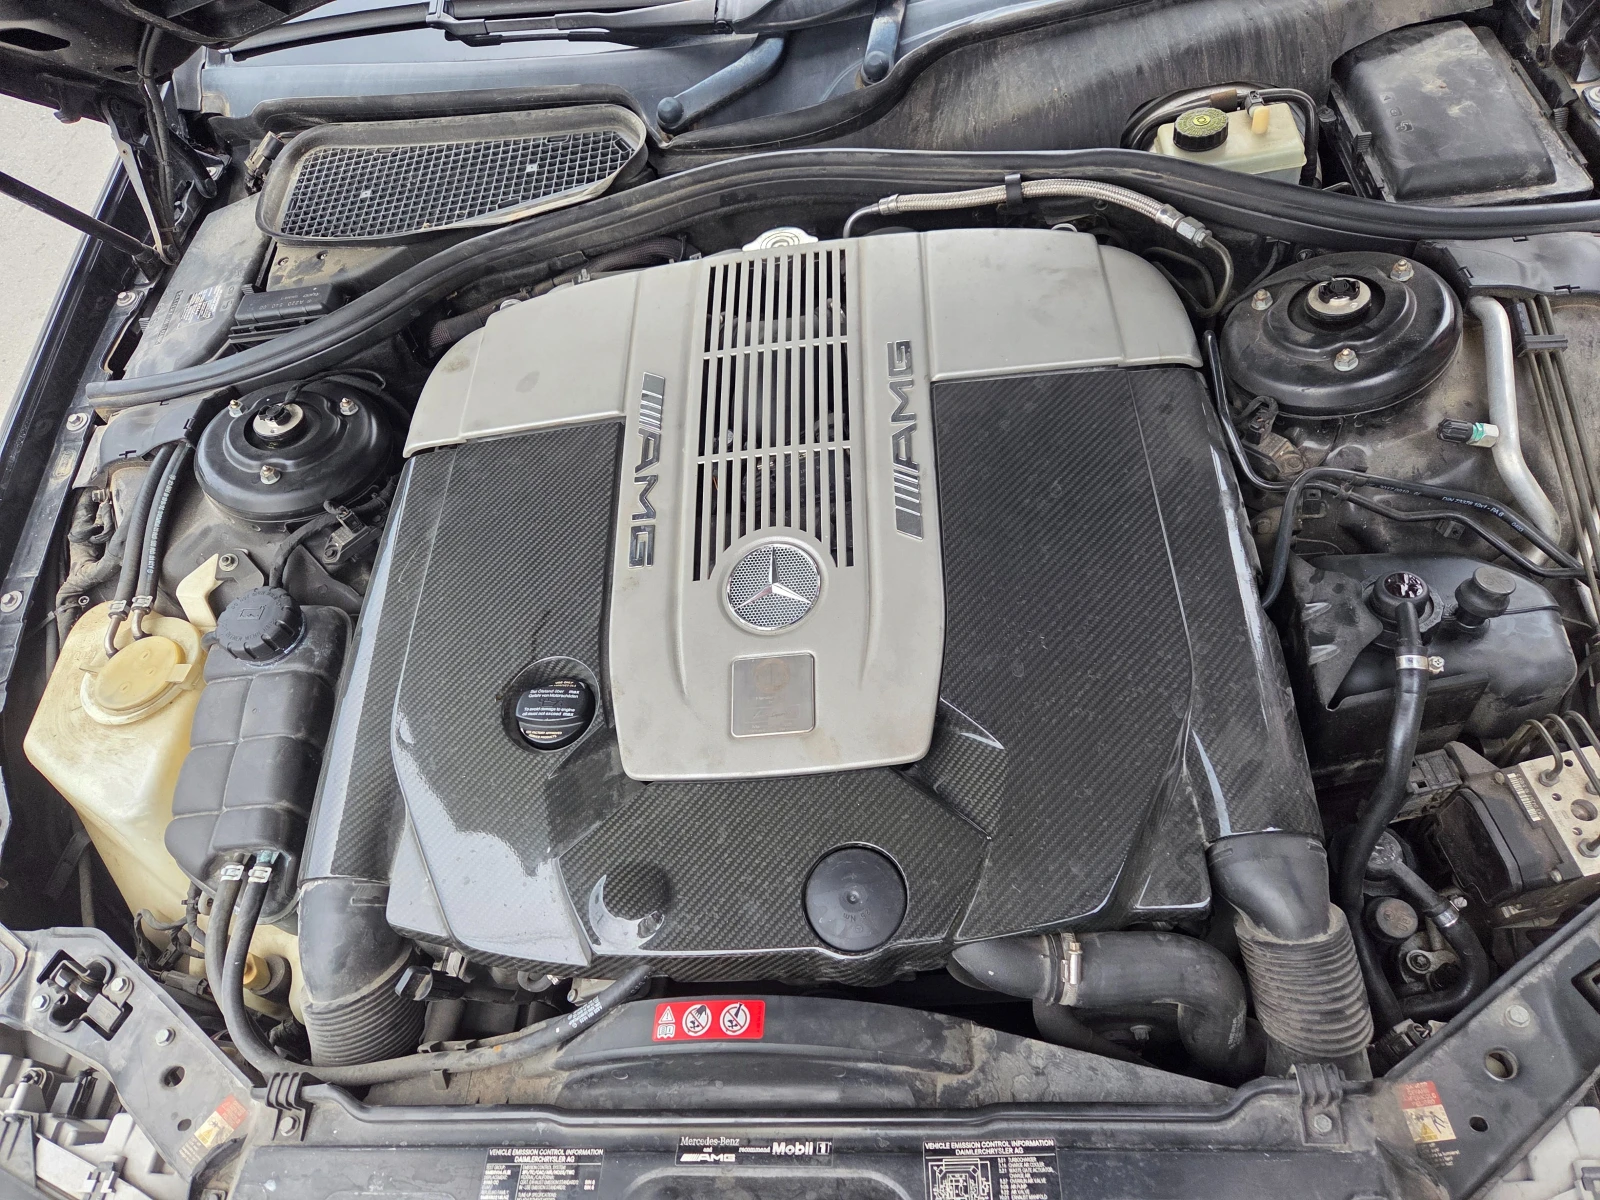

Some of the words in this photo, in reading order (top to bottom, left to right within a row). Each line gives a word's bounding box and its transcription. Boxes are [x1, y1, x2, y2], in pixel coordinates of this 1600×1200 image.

[886, 340, 920, 473] AMG
[629, 428, 661, 568] AMG
[680, 1136, 740, 1146] Mercedes-Benz
[772, 1142, 813, 1155] Mobil
[699, 1154, 736, 1162] AMG
